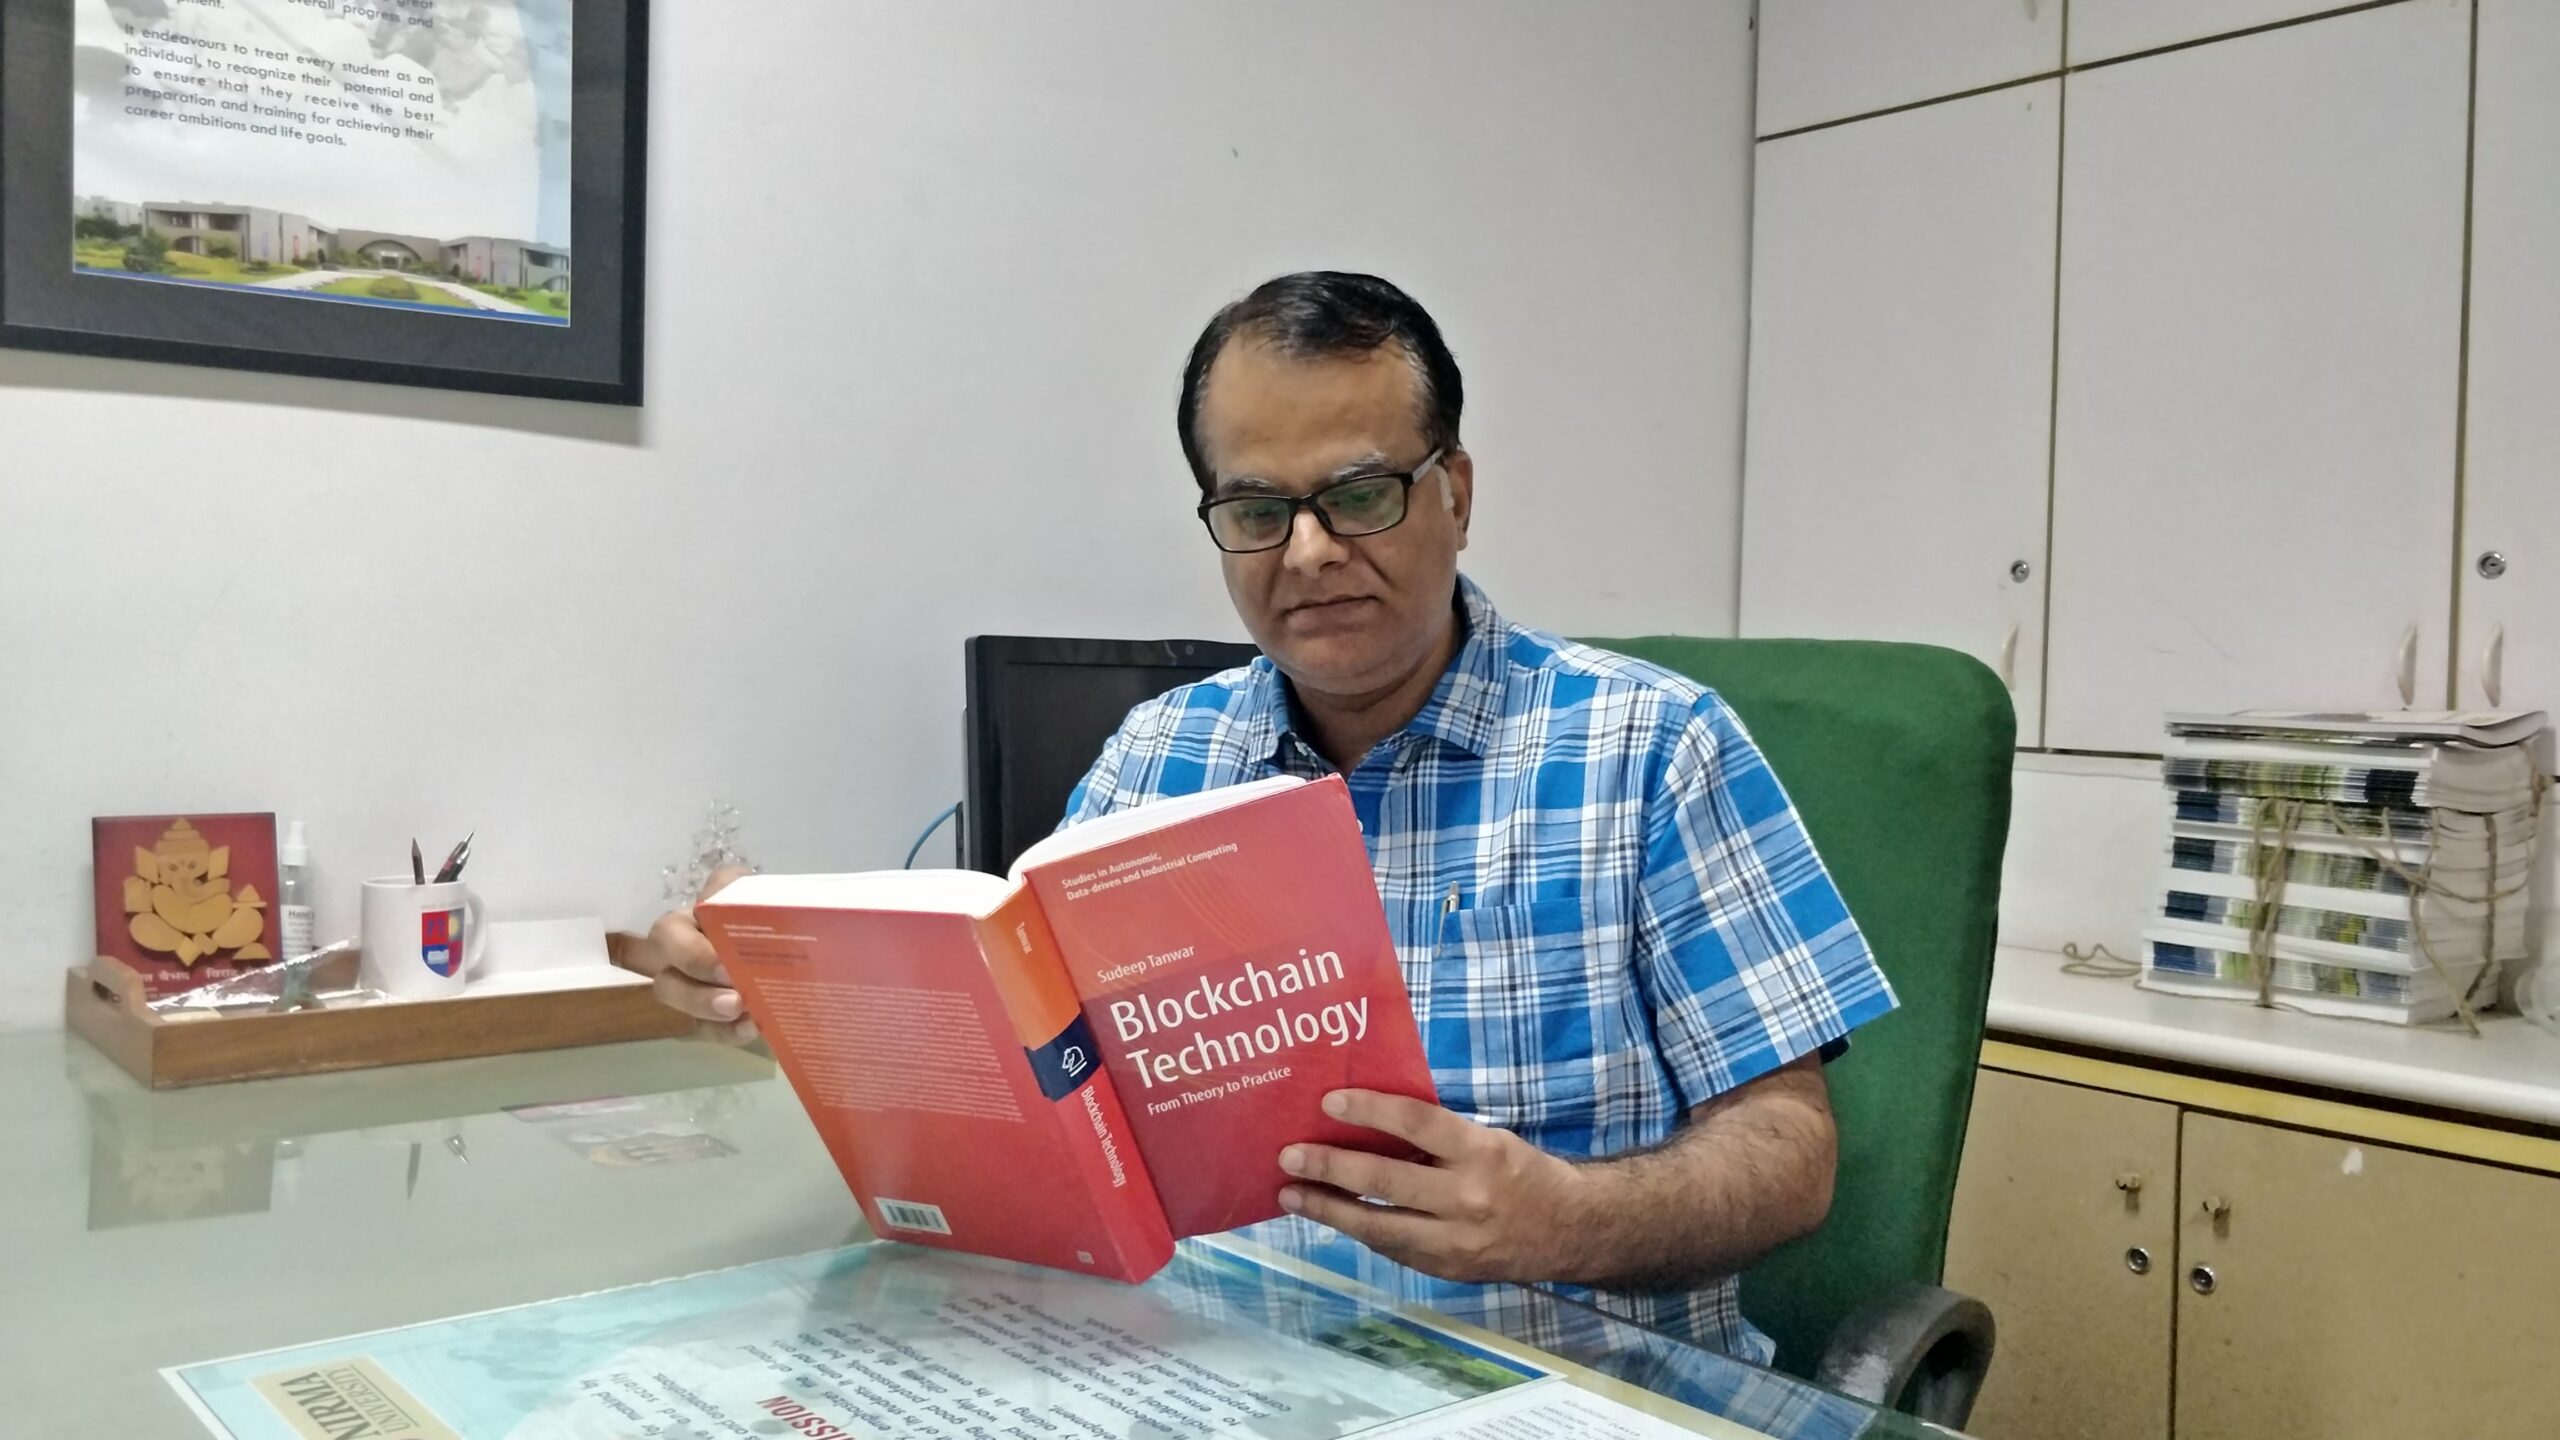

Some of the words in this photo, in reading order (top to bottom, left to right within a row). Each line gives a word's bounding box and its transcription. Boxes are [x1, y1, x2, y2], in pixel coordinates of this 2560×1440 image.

[343, 4, 400, 22] progress
[408, 16, 433, 28] and
[125, 23, 134, 35] It
[142, 29, 227, 51] endeavours
[233, 43, 248, 55] to
[254, 47, 289, 62] treat
[296, 52, 335, 71] every
[342, 61, 390, 79] student
[397, 72, 412, 82] as
[417, 75, 434, 86] an
[125, 43, 202, 68] individual,
[207, 59, 221, 70] to
[227, 64, 296, 82] recognize
[301, 72, 332, 87] their
[344, 81, 404, 99] potential
[409, 92, 434, 103] and
[125, 65, 141, 76] to
[153, 70, 206, 87] ensure
[218, 78, 249, 93] that
[260, 85, 293, 103] they
[304, 93, 360, 111] receive
[370, 103, 393, 116] the
[404, 107, 434, 122] best
[124, 105, 174, 120] career
[178, 112, 247, 132] ambitions
[250, 122, 277, 136] and
[280, 125, 303, 140] life
[306, 132, 347, 146] goals.
[125, 85, 216, 107] preparation
[220, 99, 249, 113] and
[253, 103, 306, 124] training
[312, 112, 331, 125] for
[336, 117, 400, 138] achieving
[405, 126, 434, 140] their
[1061, 872, 1098, 889] Studies
[1098, 868, 1108, 878] in
[1109, 852, 1162, 875] Autonomic,
[1066, 879, 1122, 901] Data-driven
[1123, 870, 1140, 884] and
[1141, 857, 1186, 877] Industrial
[1186, 843, 1238, 864] Computing
[1015, 921, 1033, 955] Tanwar
[1097, 959, 1147, 985] Sudeep
[1147, 945, 1195, 969] Tanwar
[1110, 948, 1345, 1042] Blockchain
[1125, 996, 1368, 1089] Technology
[1147, 1096, 1181, 1117] From
[1182, 1084, 1225, 1106] Theory
[1226, 1078, 1240, 1093] to
[1241, 1065, 1292, 1089] Practice
[1080, 1084, 1107, 1140] Blockchain
[1099, 1132, 1126, 1188] Technology
[1001, 1348, 1037, 1364] every
[1084, 1353, 1114, 1366] they
[1095, 1340, 1147, 1364] training
[1139, 1345, 1173, 1357] and
[579, 1380, 599, 1389] by
[812, 1364, 842, 1378] aims
[1034, 1365, 1070, 1382] treat
[1053, 1355, 1119, 1386] recognize
[1121, 1371, 1154, 1385] that
[1143, 1364, 1178, 1377] and
[1172, 1358, 1240, 1387] ambitions
[325, 1369, 411, 1433] UNIVERSITY
[610, 1374, 660, 1402] socially
[974, 1388, 992, 1397] its
[993, 1398, 1010, 1406] in
[1073, 1384, 1090, 1392] to
[1163, 1390, 1212, 1411] ensure
[1177, 1378, 1271, 1420] preparation
[1244, 1391, 1292, 1411] career
[279, 1372, 381, 1440] NIRMA
[591, 1392, 643, 1420] mankind
[658, 1408, 691, 1426] and
[757, 1396, 854, 1440] ISSION
[819, 1391, 892, 1430] emphasizes
[921, 1405, 967, 1424] good
[952, 1399, 999, 1422] worthy
[1011, 1407, 1058, 1431] aiding
[1090, 1393, 1173, 1433] endeavours
[1137, 1397, 1217, 1434] individual,
[640, 1425, 666, 1436] for
[715, 1420, 748, 1434] and
[902, 1416, 922, 1425] its
[1222, 1418, 1240, 1426] to
